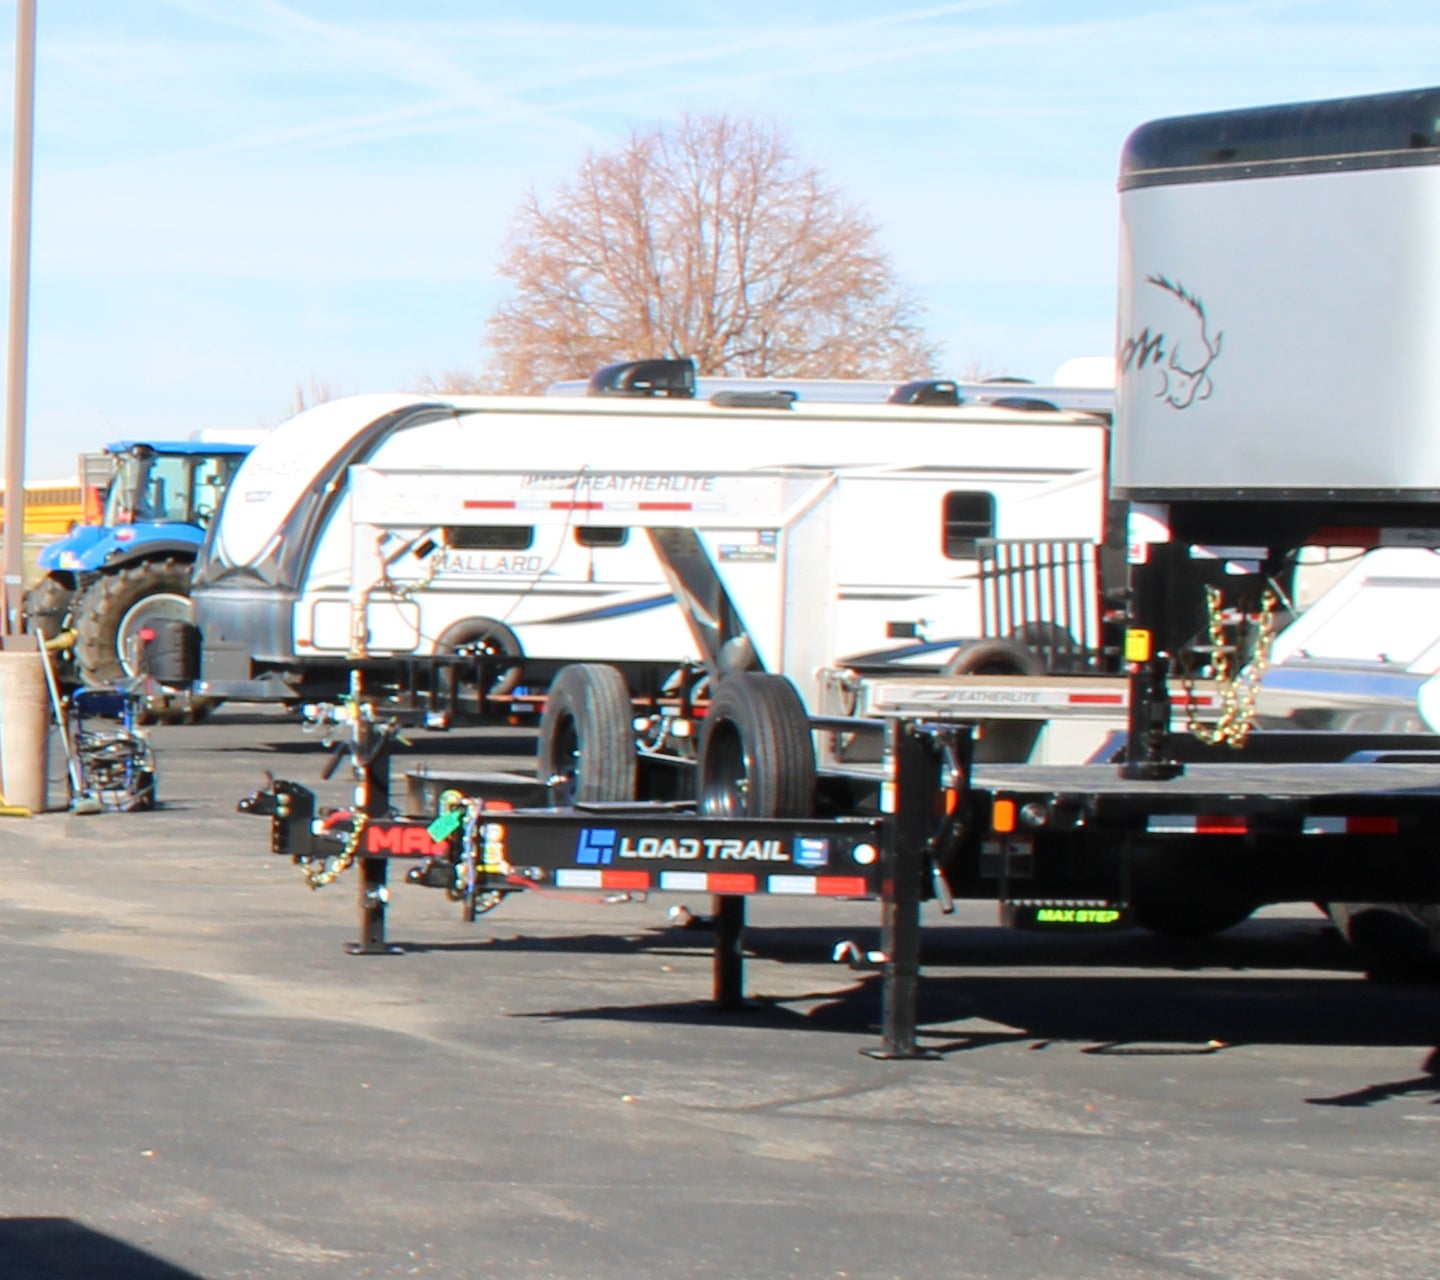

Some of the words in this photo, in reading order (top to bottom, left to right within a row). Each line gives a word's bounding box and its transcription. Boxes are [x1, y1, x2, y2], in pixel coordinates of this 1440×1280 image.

[618, 837, 702, 859] LOAD
[703, 839, 791, 861] TRAIL
[1037, 908, 1075, 922] MAX
[1075, 909, 1120, 923] STEP
